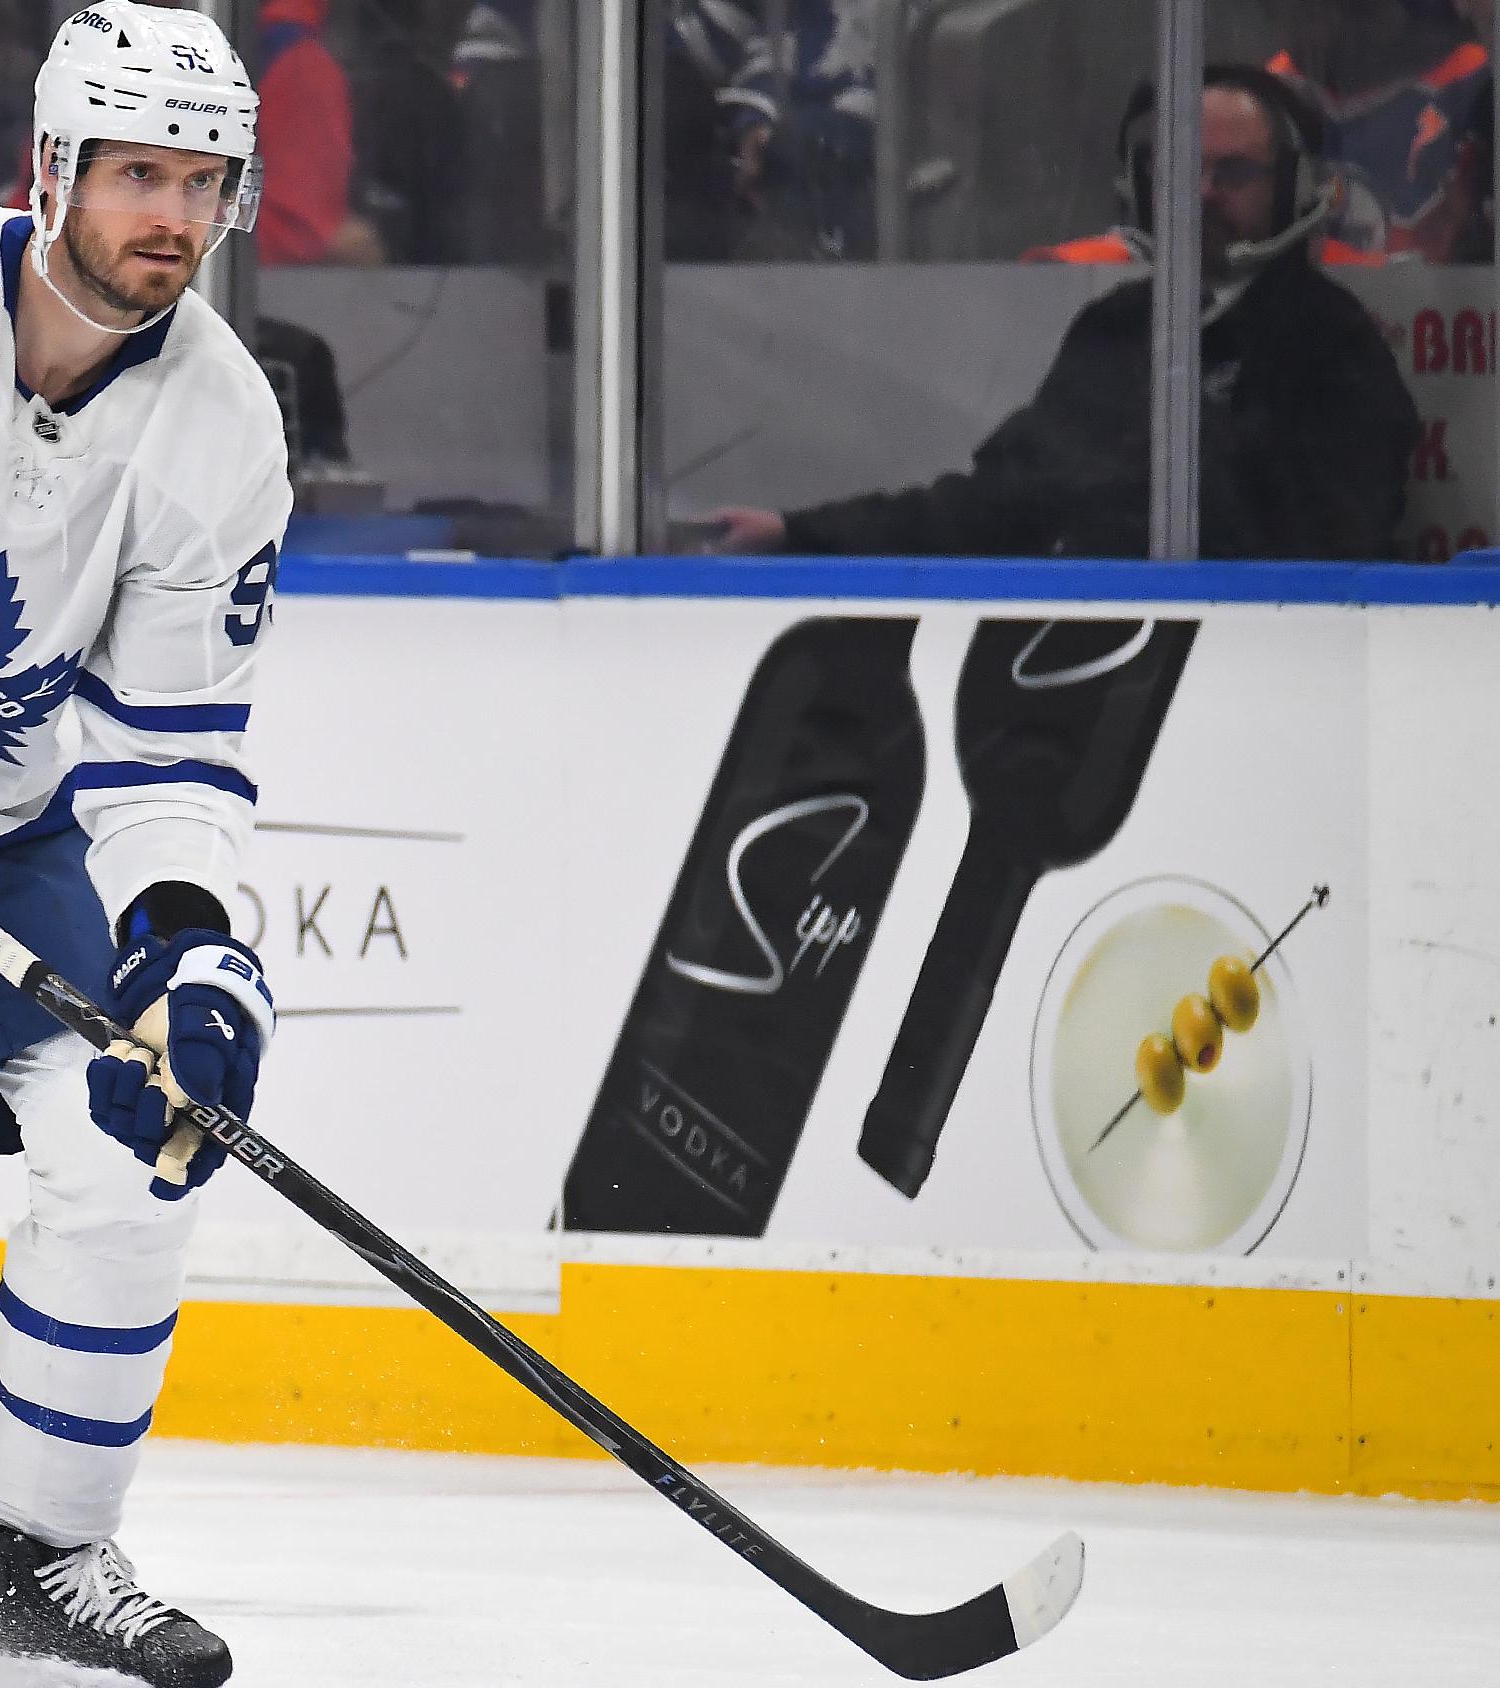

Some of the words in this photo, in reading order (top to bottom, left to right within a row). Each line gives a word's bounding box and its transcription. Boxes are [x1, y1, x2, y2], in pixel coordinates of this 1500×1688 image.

[72, 11, 113, 33] OREO
[165, 98, 228, 116] BAUER
[224, 539, 277, 647] 9
[665, 792, 870, 995] Sipp
[640, 1080, 749, 1191] VODKA
[654, 1473, 764, 1558] FLYLITE
